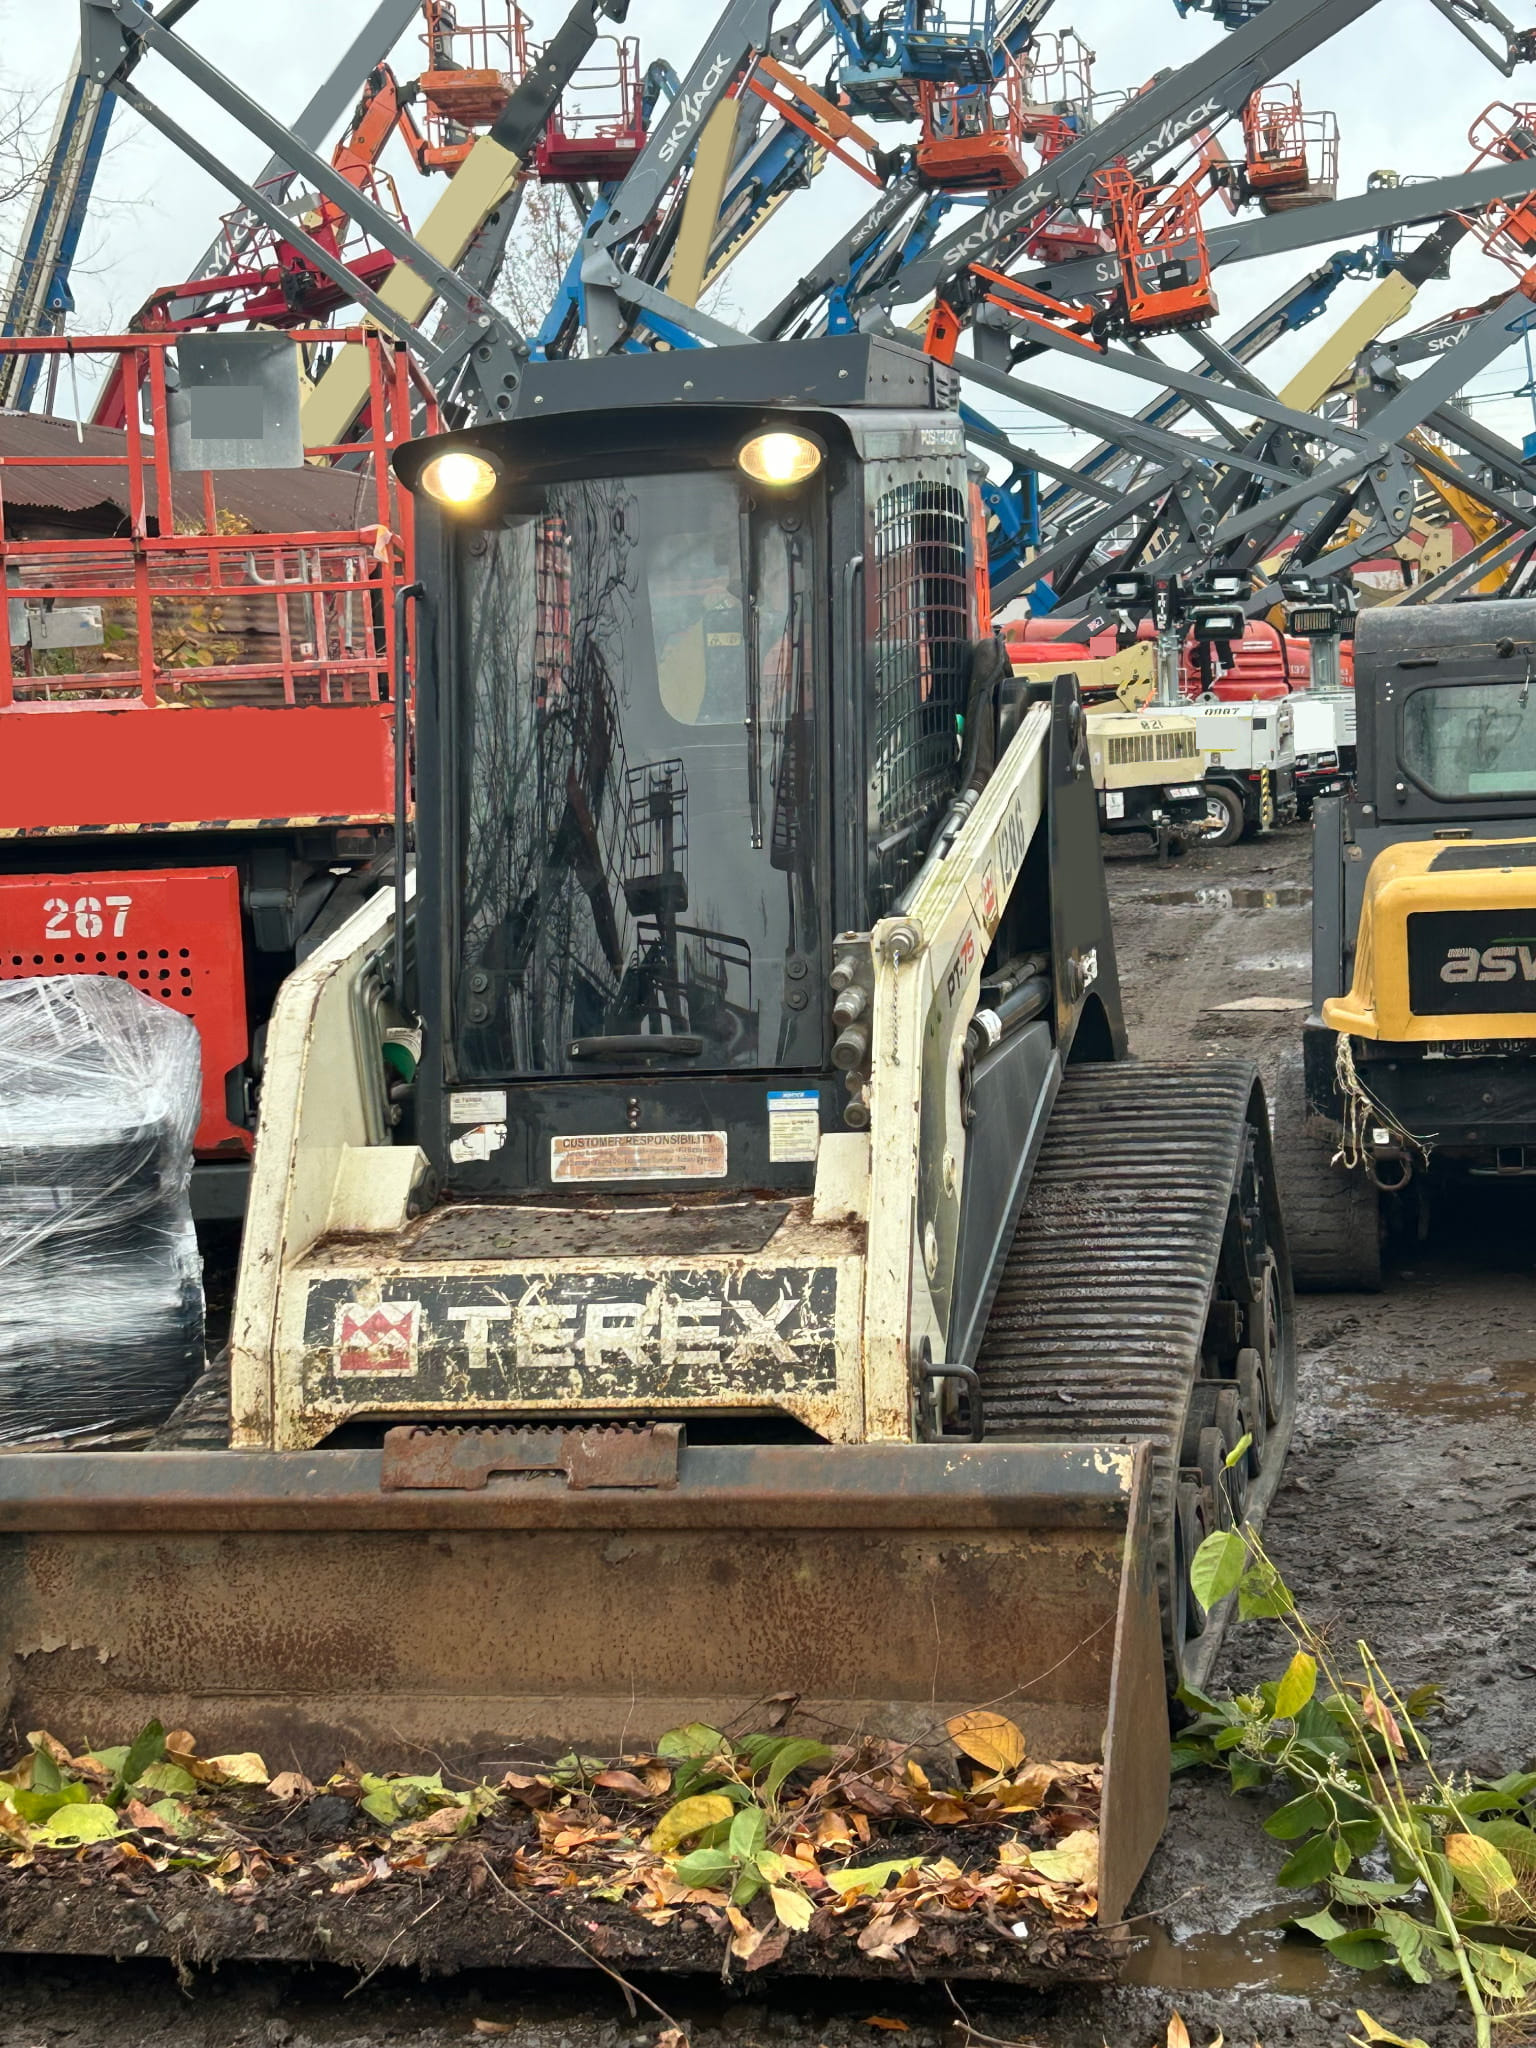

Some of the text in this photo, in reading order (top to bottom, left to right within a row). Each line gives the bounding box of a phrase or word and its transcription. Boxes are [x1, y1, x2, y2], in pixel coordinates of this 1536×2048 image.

[658, 53, 731, 162] SKYJACK
[1125, 97, 1221, 171] SKYJACK
[851, 195, 902, 246] SKYJACK
[943, 182, 1052, 266] SKYJACK
[43, 895, 133, 939] 267
[947, 929, 975, 1008] PT-75
[563, 1133, 715, 1148] CUSTOMER RESPONSIBILITY
[446, 1297, 801, 1369] TEREX
